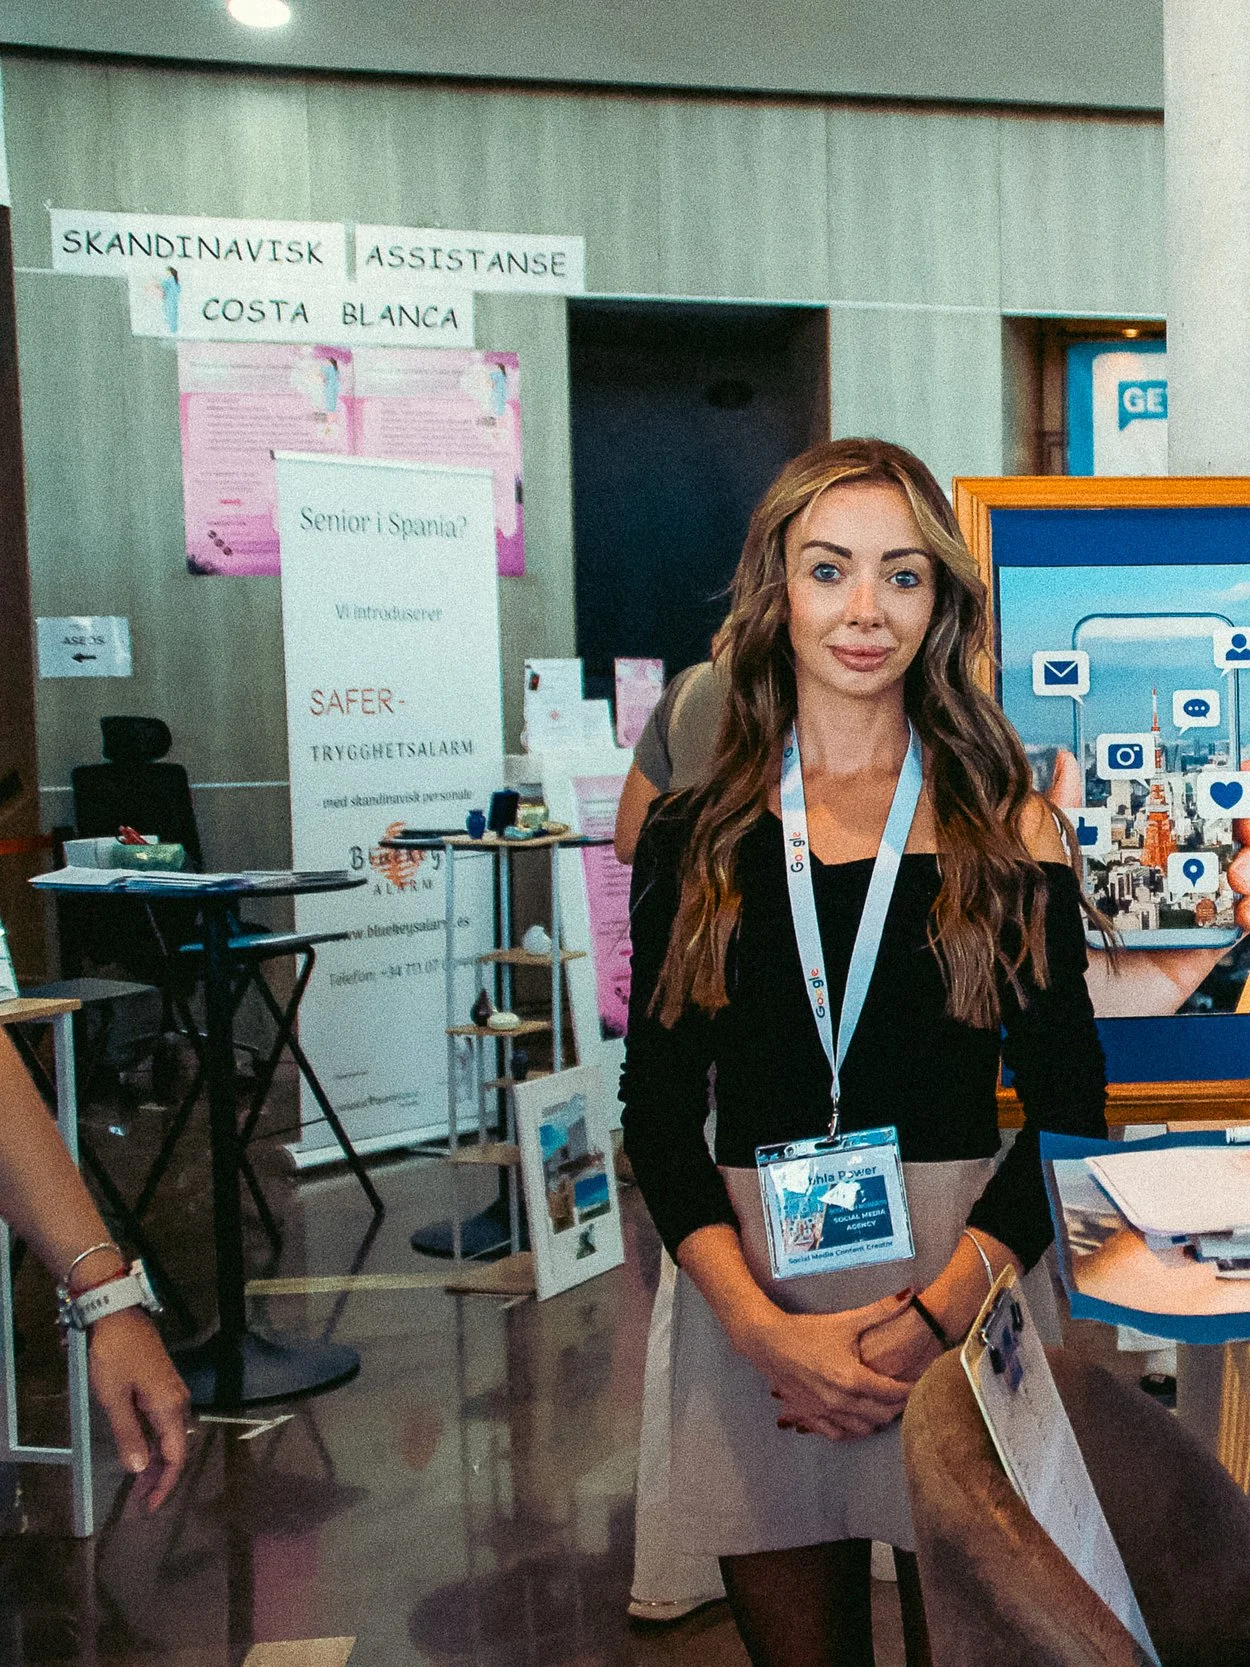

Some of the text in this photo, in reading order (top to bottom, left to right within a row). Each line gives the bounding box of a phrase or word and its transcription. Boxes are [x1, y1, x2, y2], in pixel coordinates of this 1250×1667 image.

[62, 228, 567, 277] SKANDINAVISK ASSISTANSE
[203, 297, 459, 330] COSTA BLANCA
[300, 506, 468, 540] Senior i Spania?
[310, 687, 406, 716] SAFER-
[310, 739, 474, 763] TRYGGHETSALARM
[323, 794, 347, 809] med
[790, 830, 806, 874] Google
[807, 966, 826, 1020] Google
[833, 1213, 861, 1225] SOCIAL
[861, 1208, 886, 1219] MEDIA
[846, 1220, 877, 1231] AGENCY
